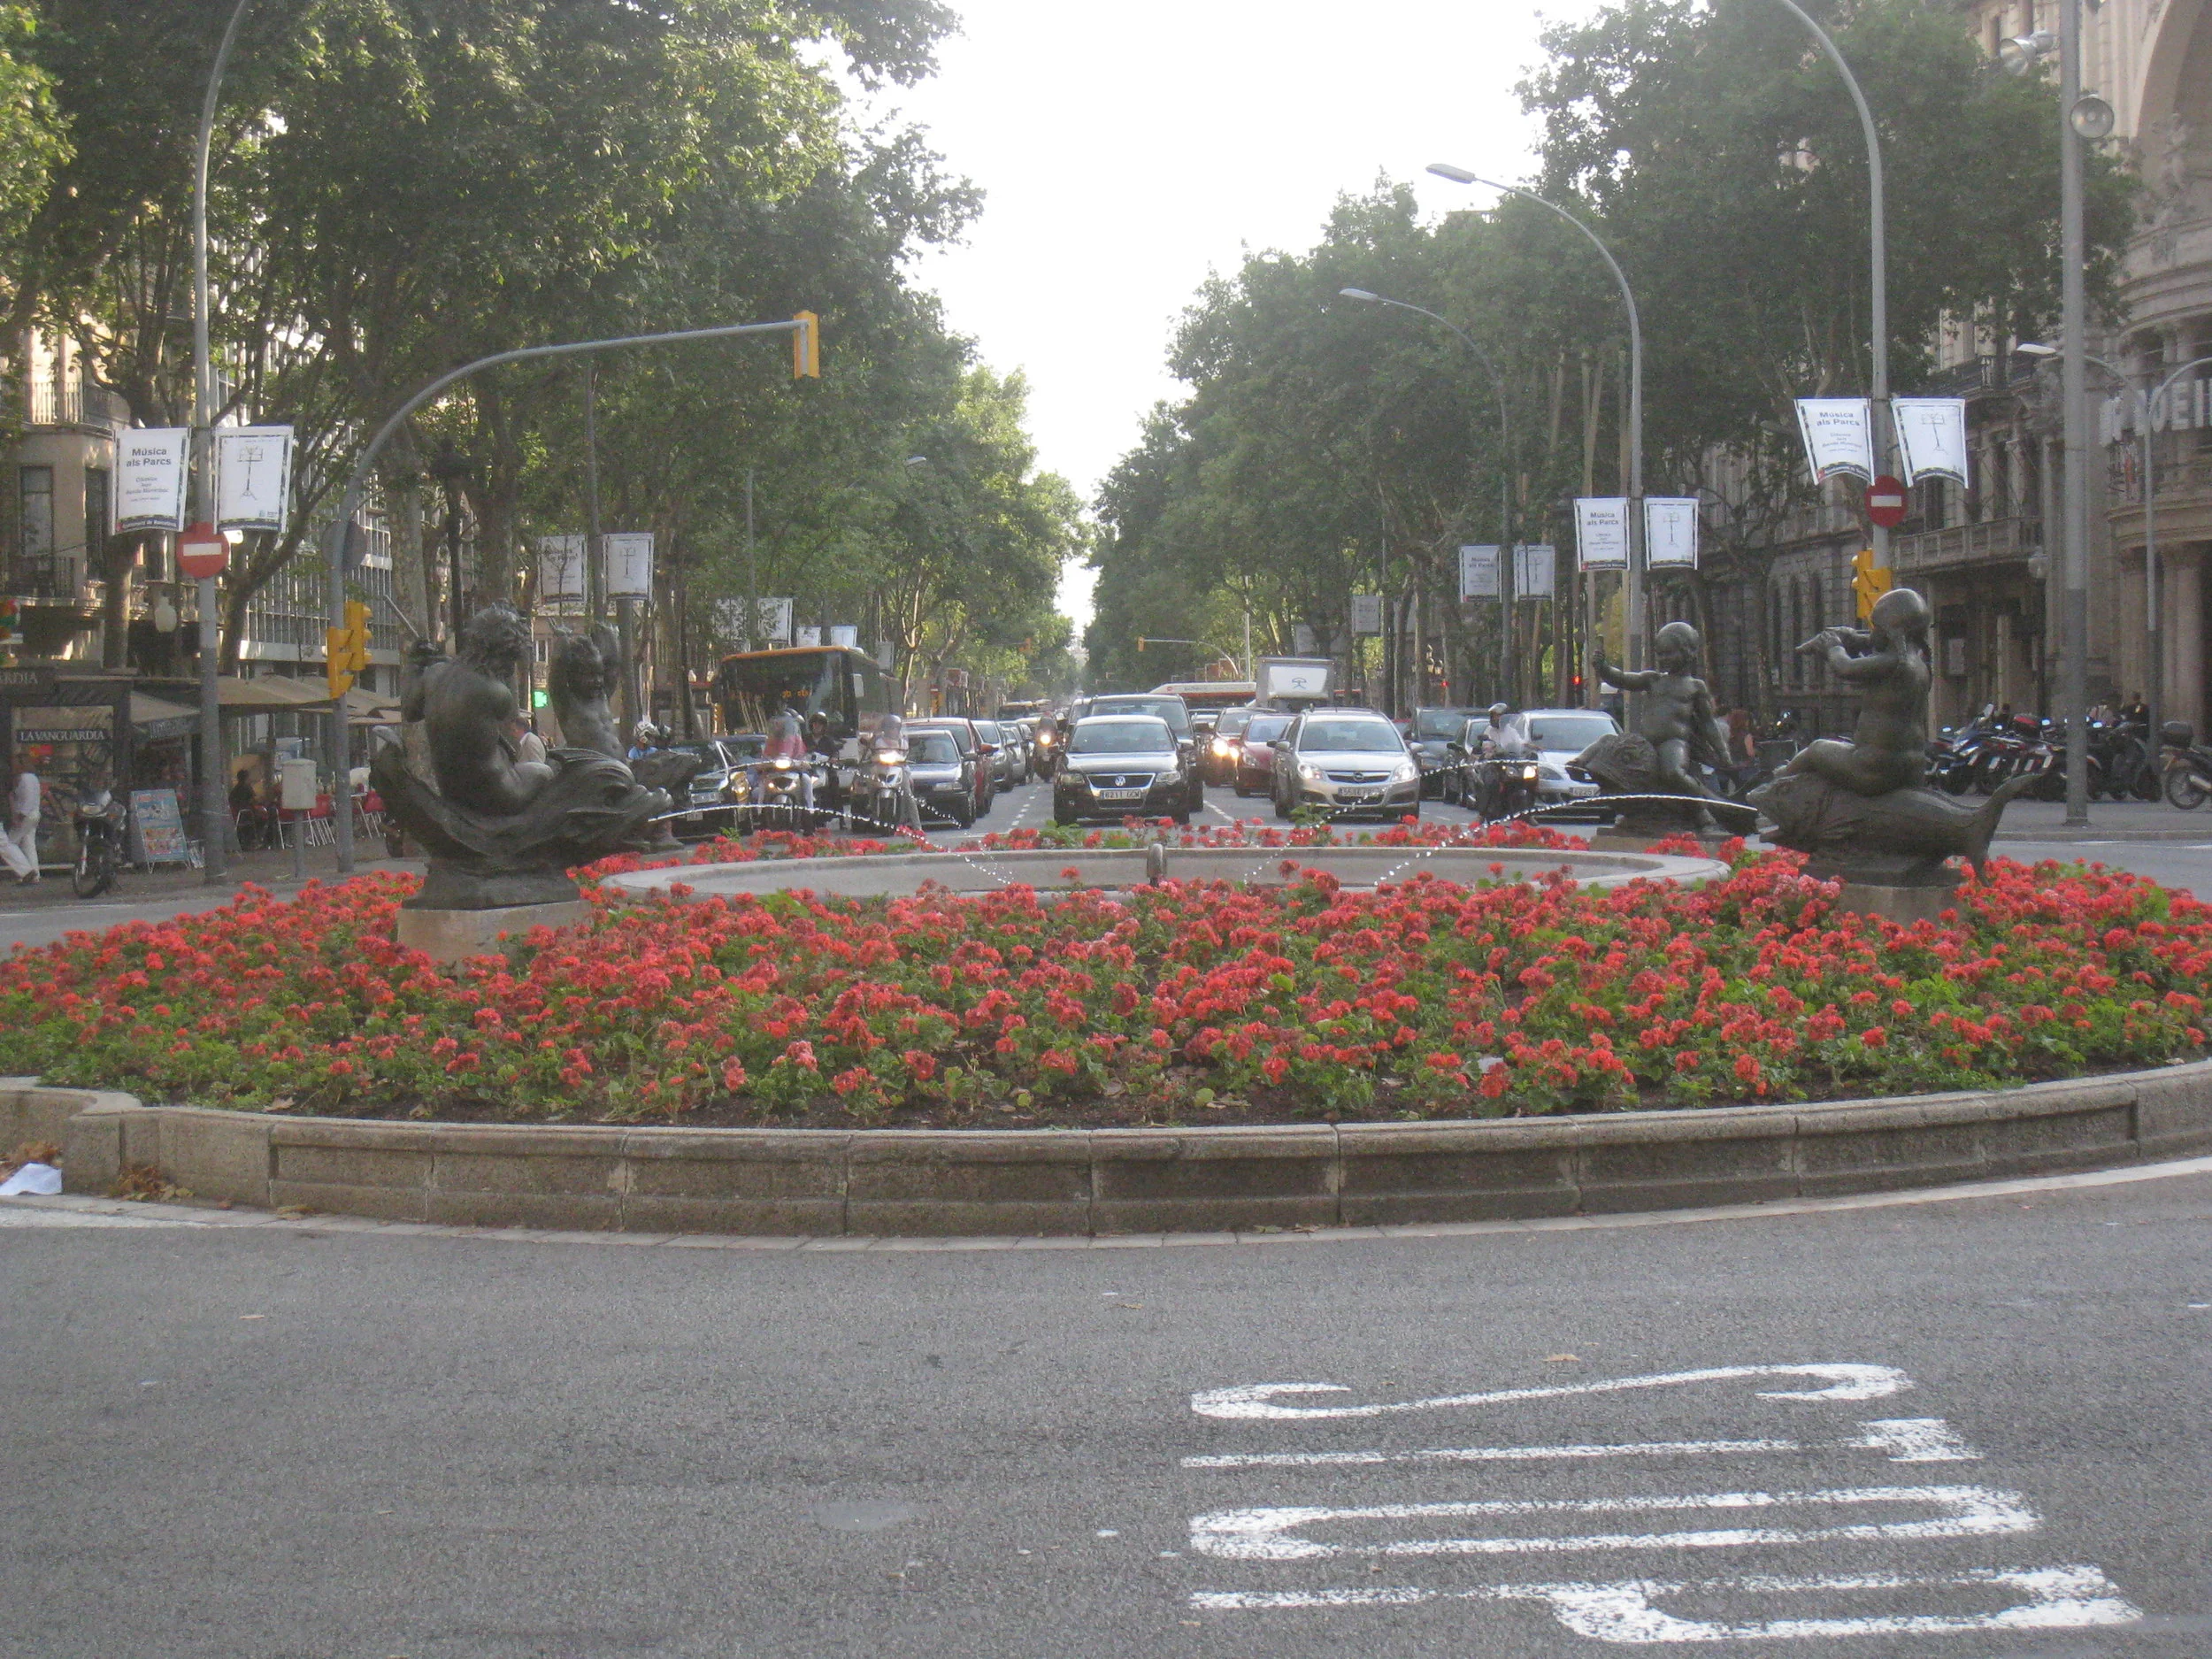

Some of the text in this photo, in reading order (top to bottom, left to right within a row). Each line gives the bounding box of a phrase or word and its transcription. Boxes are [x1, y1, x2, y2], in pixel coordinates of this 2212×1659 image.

[132, 447, 167, 457] Música
[126, 457, 172, 467] als Parcs
